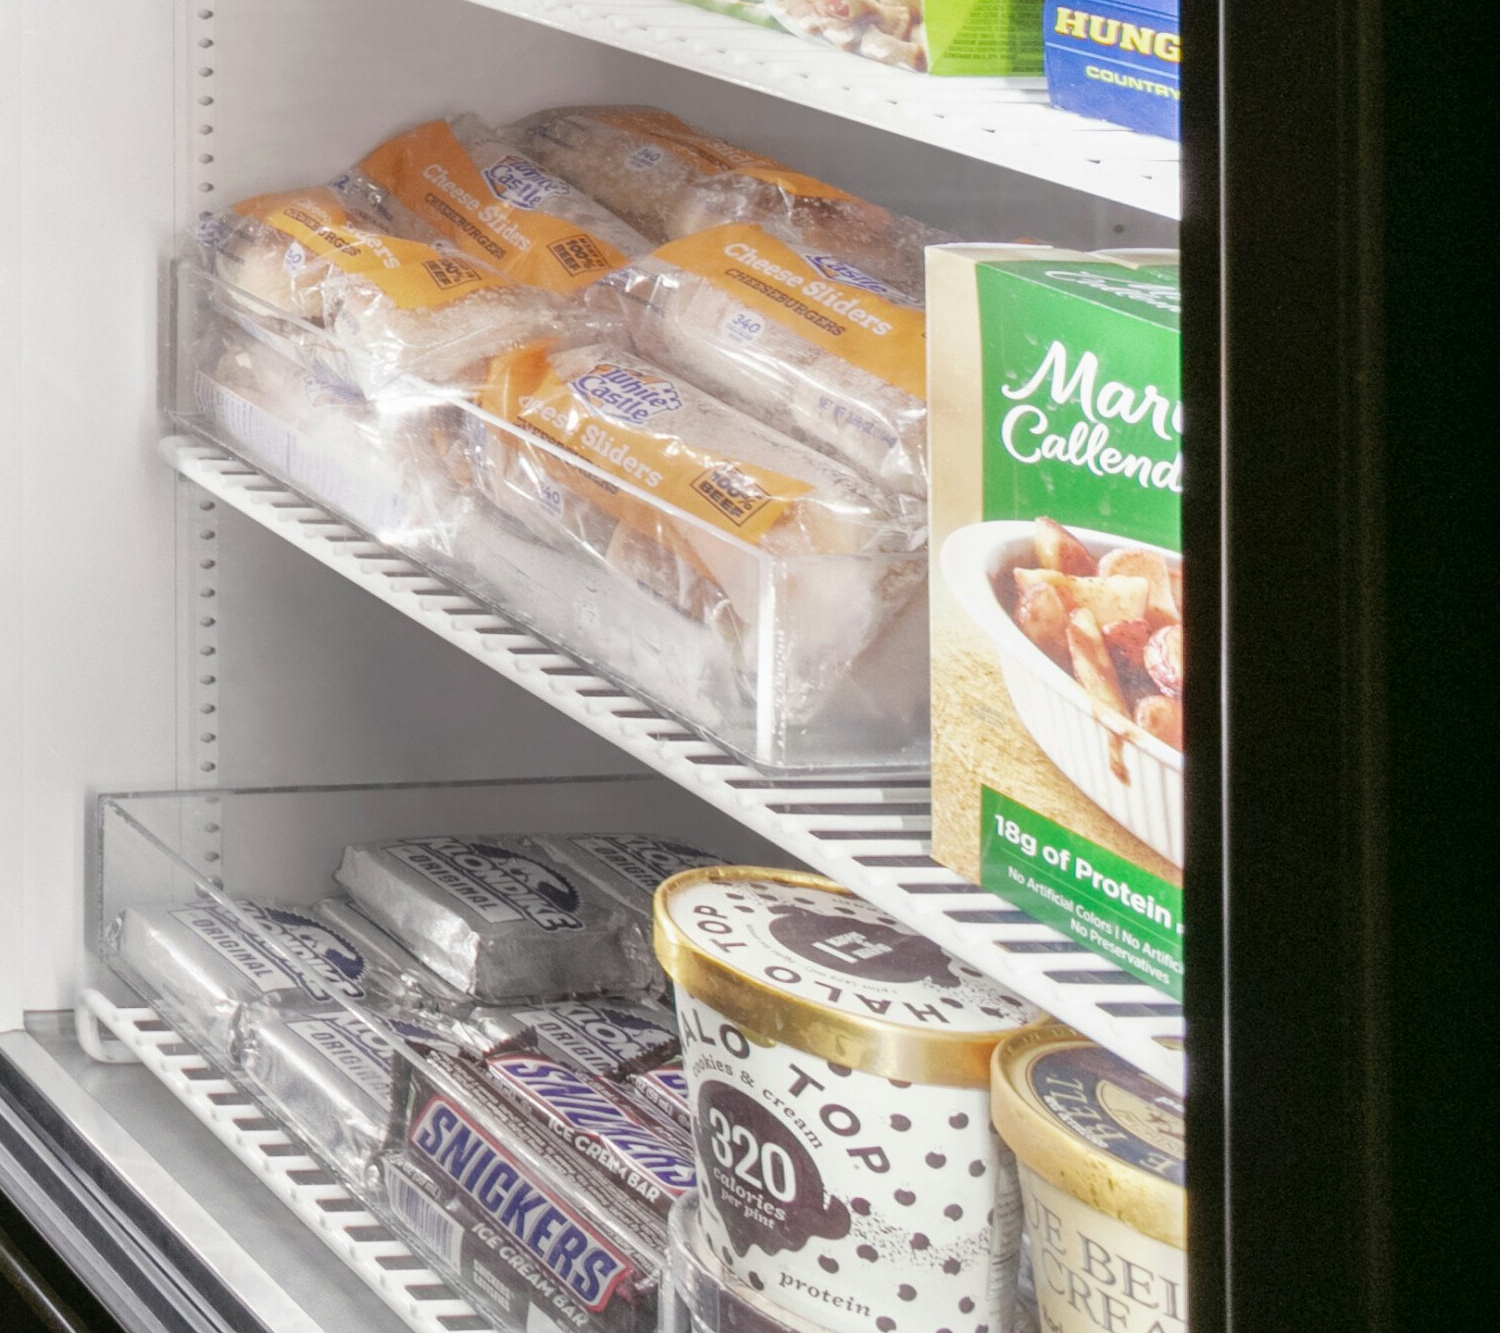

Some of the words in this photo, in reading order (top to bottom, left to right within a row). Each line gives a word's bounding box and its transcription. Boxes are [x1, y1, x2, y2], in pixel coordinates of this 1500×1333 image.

[1054, 6, 1181, 62] HUNG
[1085, 66, 1181, 99] COUNTRY
[422, 163, 480, 212] Cheese
[477, 202, 532, 252] Sliders
[484, 165, 543, 206] Castle
[723, 242, 805, 288] Cheese
[802, 281, 892, 336] Sliders
[724, 268, 846, 337] CHEESEBURGERS
[732, 313, 761, 334] 340
[579, 375, 649, 421] Castle
[581, 423, 663, 488] Sliders
[699, 482, 745, 519] BEEF
[408, 853, 502, 911] ORIGINAL
[420, 838, 584, 931] KLONDIKE
[995, 814, 1037, 857] 18g
[1042, 845, 1071, 871] of
[1075, 857, 1172, 929] Protein
[693, 905, 749, 954] TOP
[1008, 866, 1025, 885] No
[1026, 878, 1074, 913] Artificial
[1075, 904, 1113, 936] Colors
[1122, 930, 1140, 950] No
[191, 915, 275, 979] ORIGINAL
[1070, 918, 1088, 938] No
[1089, 929, 1171, 985] Preservatives
[764, 965, 950, 1025] HALO
[762, 1087, 825, 1151] cream
[788, 1063, 891, 1174] TOP
[550, 1116, 573, 1140] ICE
[574, 1137, 630, 1181] CREAM
[626, 1175, 661, 1202] BAR
[708, 1106, 796, 1204] 320
[418, 1104, 618, 1303] SNICKERS
[712, 1166, 788, 1223] calories
[719, 1187, 743, 1213] per
[744, 1200, 776, 1230] pint
[472, 1223, 497, 1250] ICE
[500, 1247, 552, 1297] CREAM
[552, 1295, 589, 1327] BAR
[777, 1269, 872, 1318] protein
